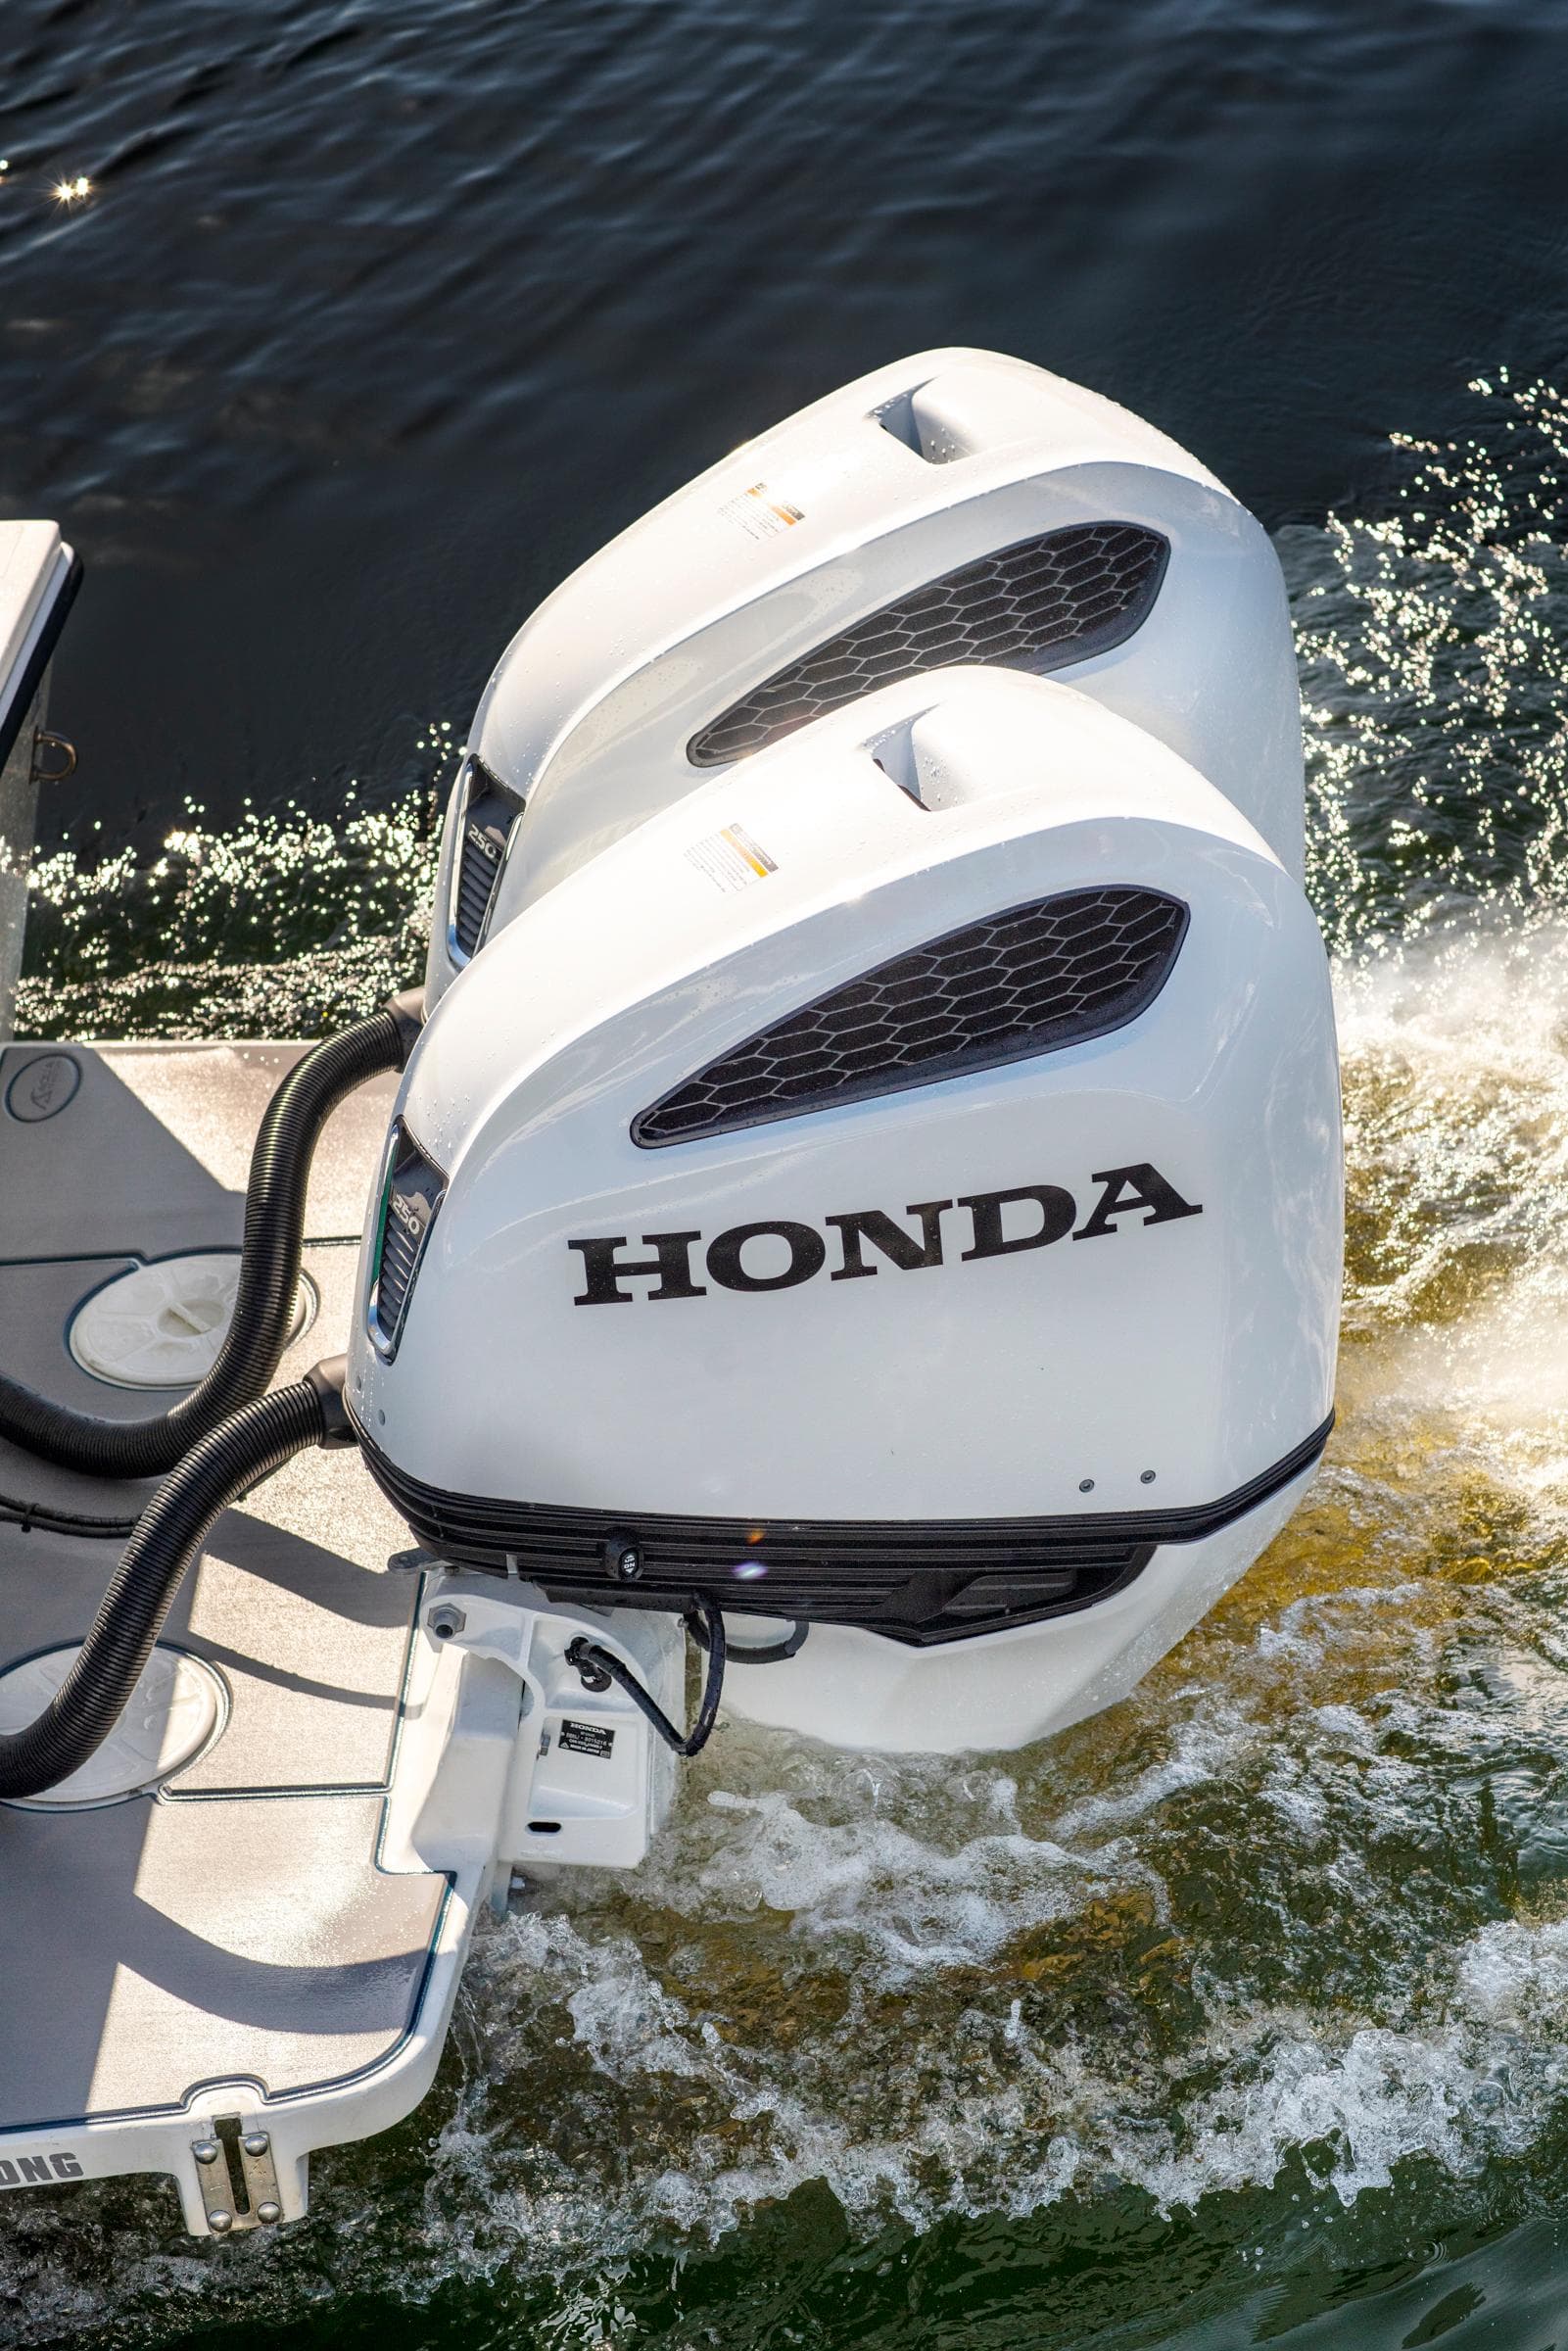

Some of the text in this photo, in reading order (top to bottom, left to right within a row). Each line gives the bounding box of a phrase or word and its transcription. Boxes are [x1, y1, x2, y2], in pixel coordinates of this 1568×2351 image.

[469, 823, 497, 859] 250
[393, 1193, 420, 1235] 250
[567, 1162, 1204, 1306] HONDA
[570, 1722, 606, 1735] HONDA
